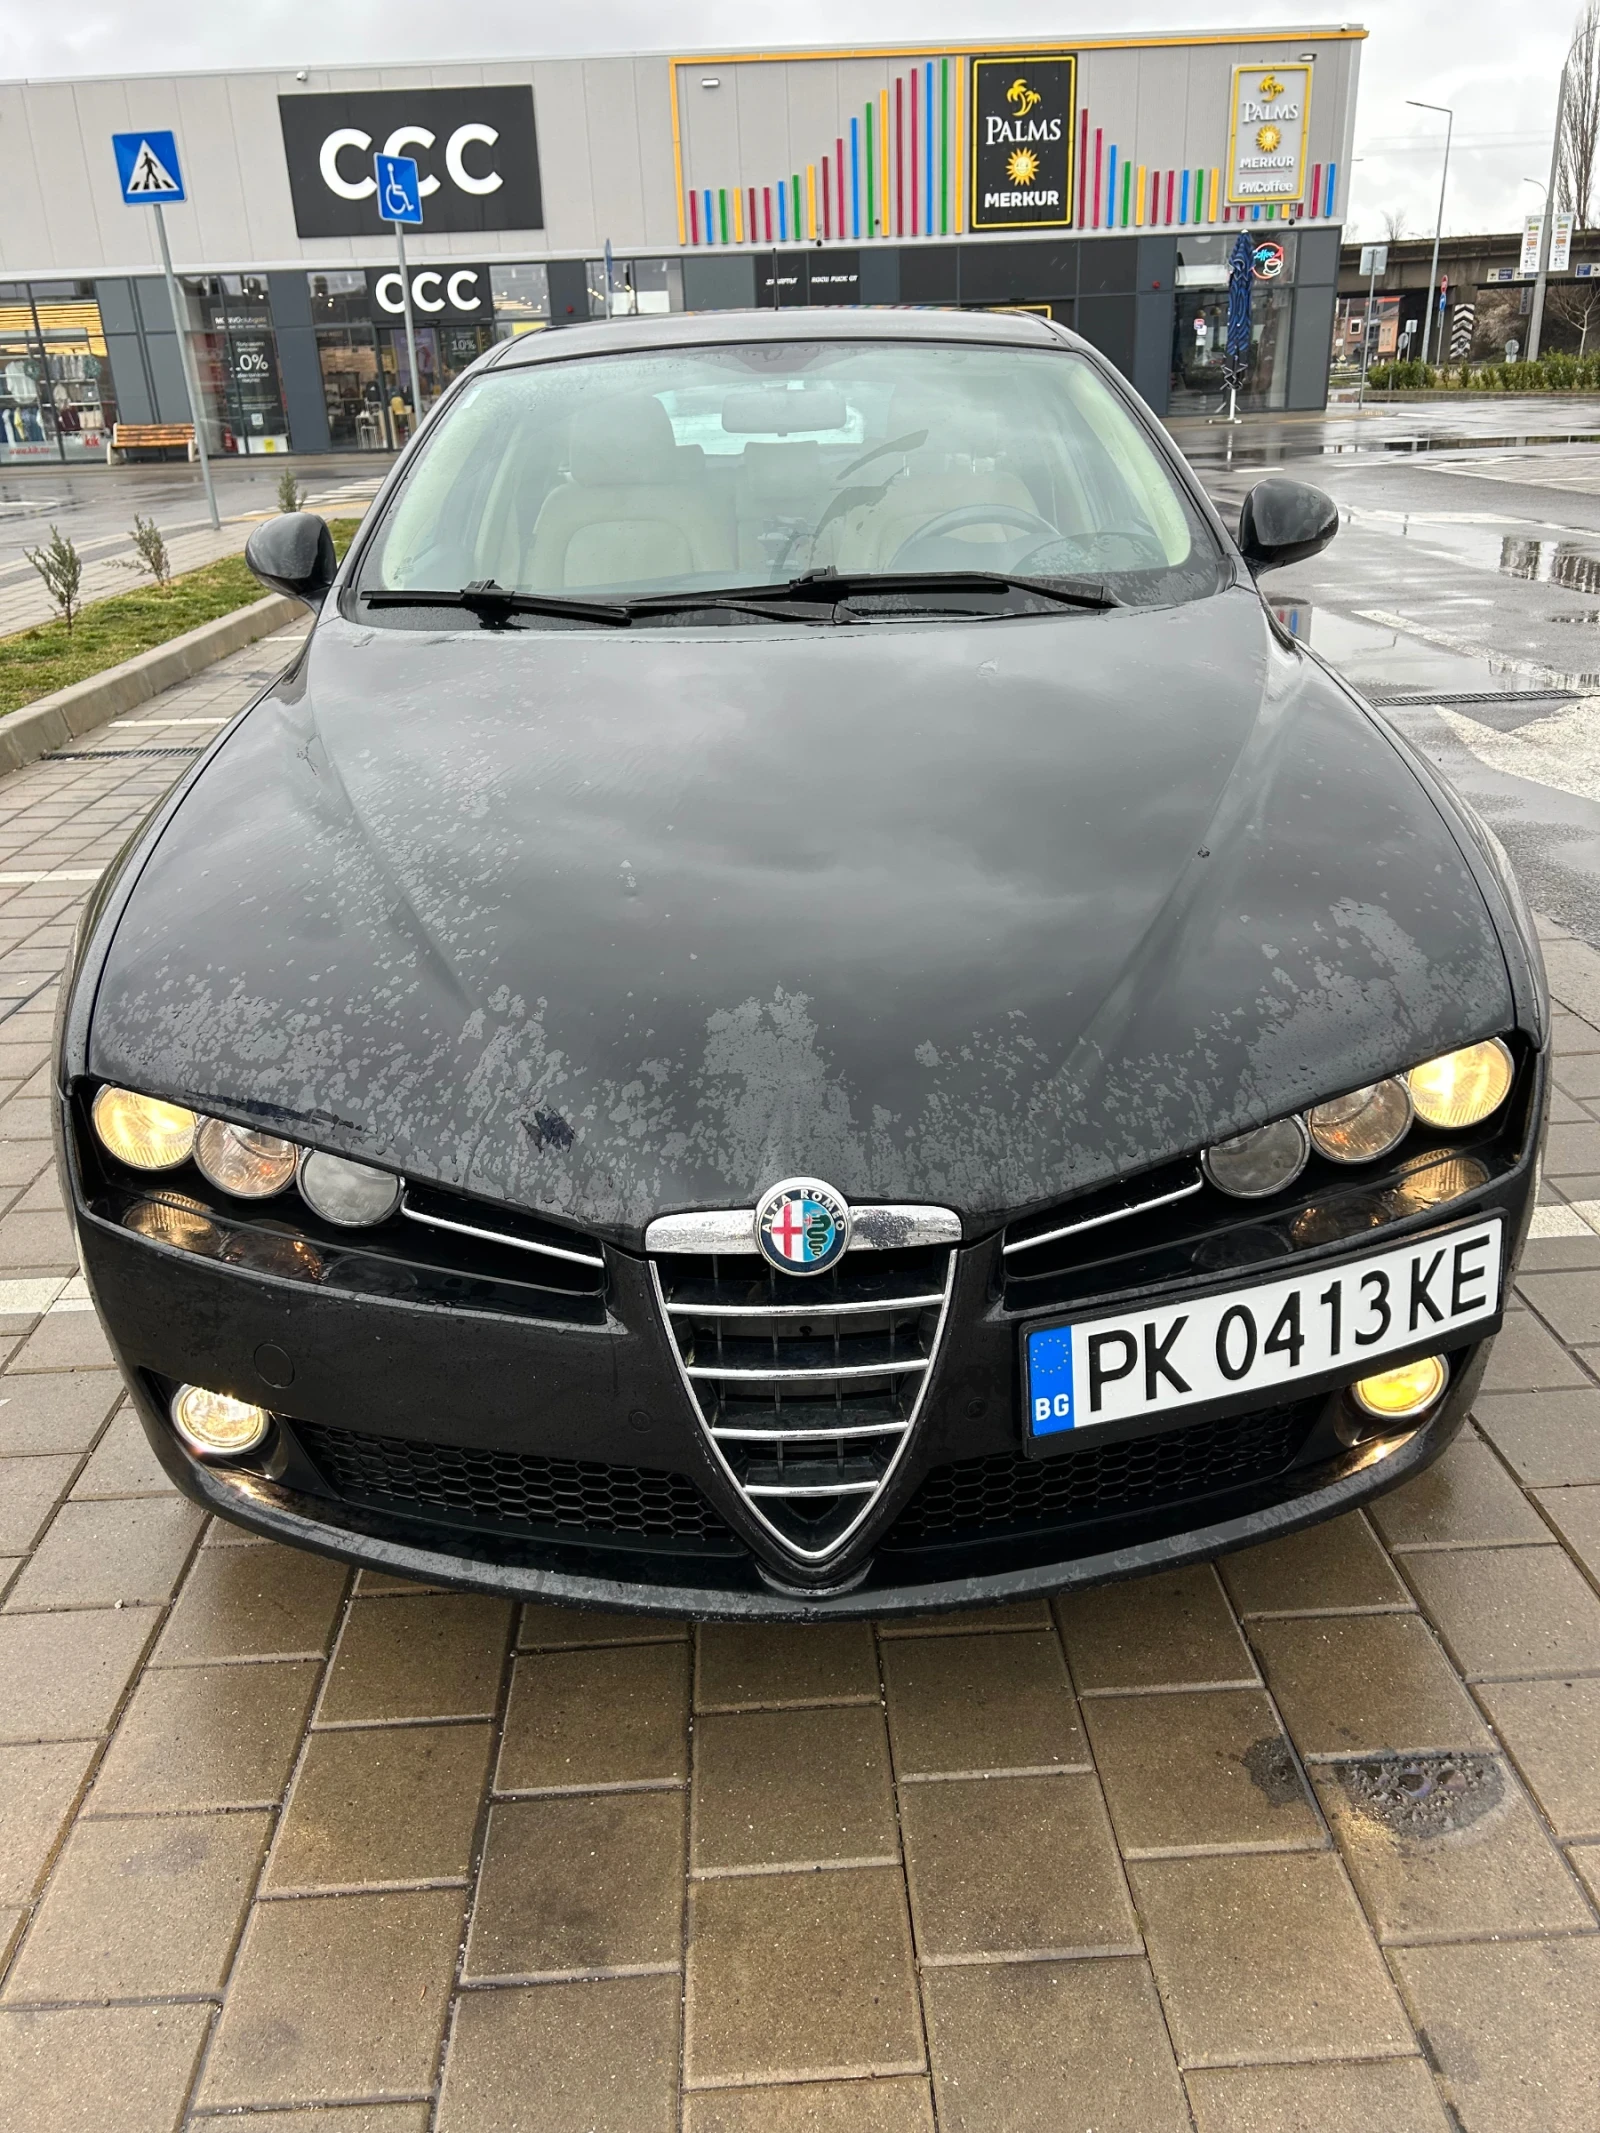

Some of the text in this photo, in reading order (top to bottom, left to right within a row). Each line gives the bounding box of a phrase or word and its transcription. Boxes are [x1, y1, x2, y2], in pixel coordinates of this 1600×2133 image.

[1243, 102, 1299, 124] PALMS
[985, 116, 1061, 145] PALMS
[319, 123, 504, 200] CCC
[1240, 156, 1295, 169] MERKUR
[984, 190, 1059, 208] MERKUR
[1239, 181, 1293, 194] PMCoffee
[375, 270, 482, 314] CCC
[762, 1189, 845, 1234] ALFA ROMEO
[1087, 1234, 1490, 1413] PK 0413 KE
[1035, 1393, 1069, 1422] BG
